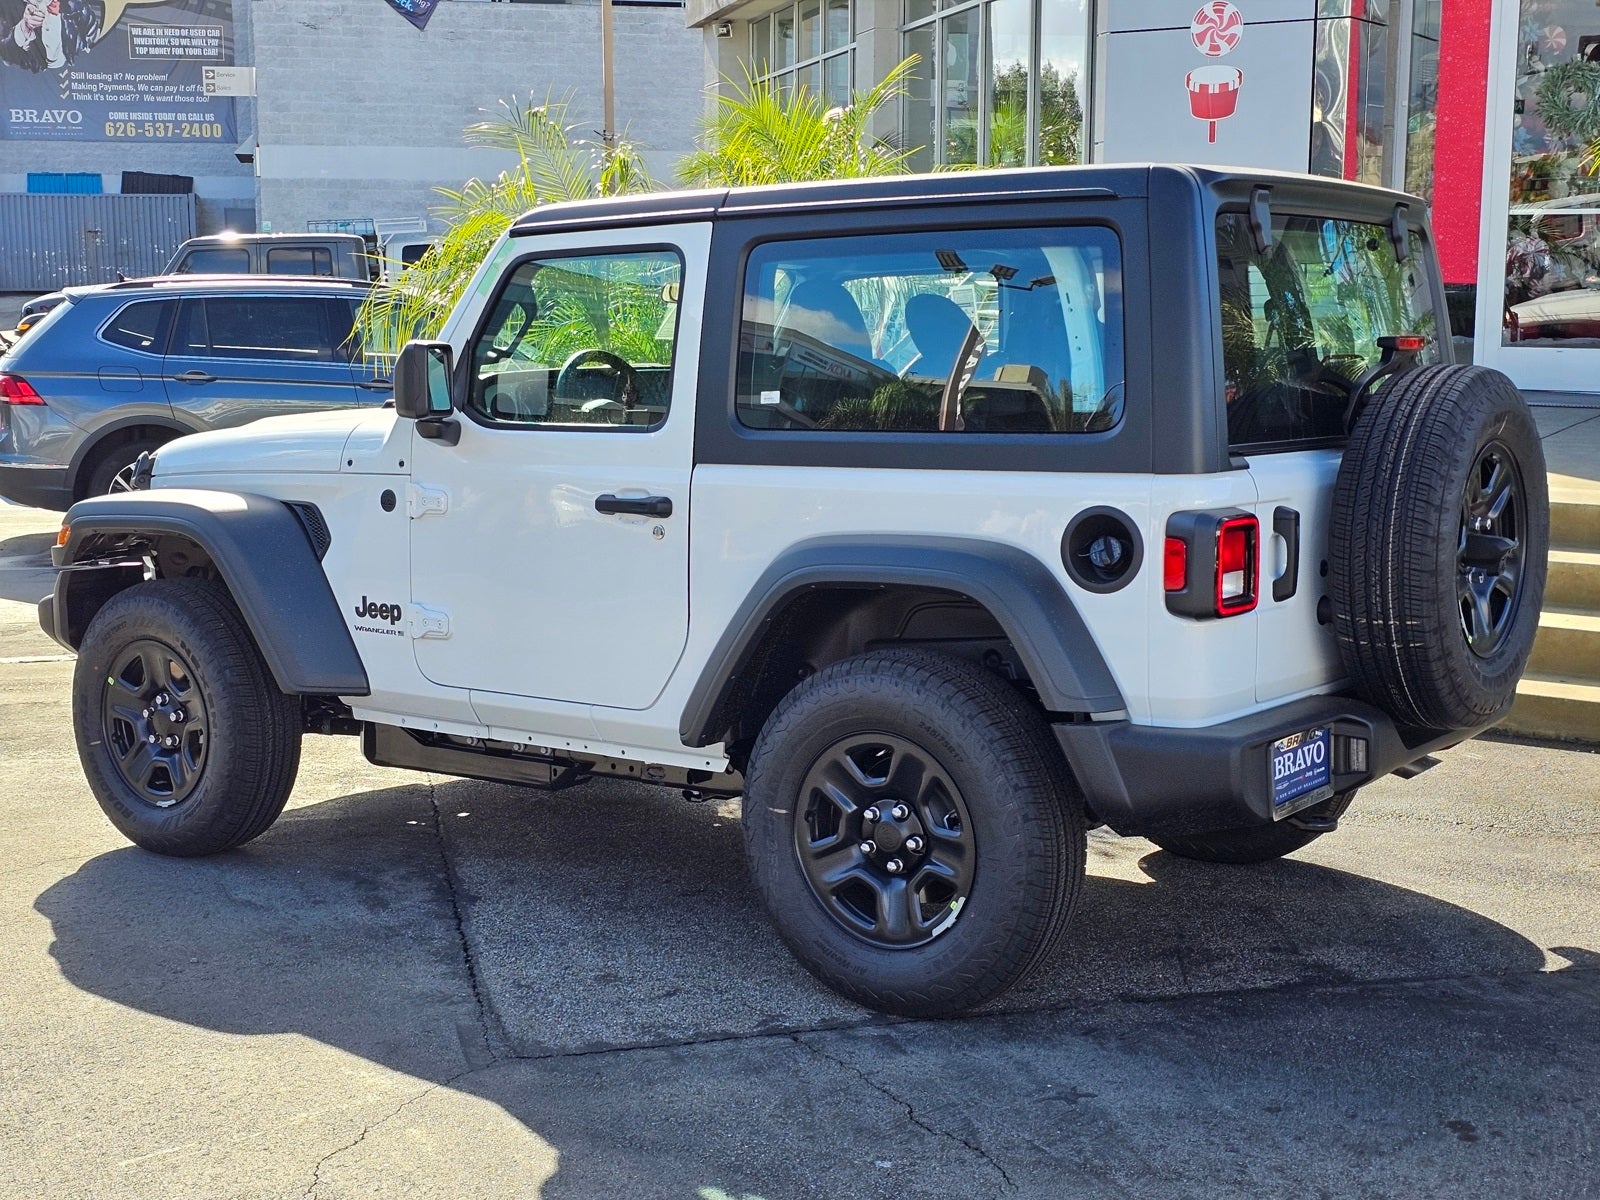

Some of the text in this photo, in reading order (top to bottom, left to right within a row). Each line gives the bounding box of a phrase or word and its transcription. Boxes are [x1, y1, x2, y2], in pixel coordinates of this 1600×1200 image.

[207, 29, 220, 37] CAR
[180, 38, 190, 46] WE
[149, 47, 171, 55] MONEY
[203, 48, 219, 56] CAR!
[70, 71, 168, 82] Still leasing it? No problem!
[71, 82, 97, 92] Making
[98, 83, 136, 93] Payments,
[137, 83, 149, 92] We
[179, 84, 185, 92] it
[185, 84, 196, 92] off
[72, 92, 93, 101] Think
[94, 93, 105, 101] it's
[105, 93, 118, 101] too
[119, 93, 140, 102] old??
[143, 94, 155, 102] We
[174, 95, 195, 103] those
[195, 95, 210, 103] too!
[9, 108, 83, 124] BRAVO
[108, 112, 215, 121] COME INSIDE TODAY OR CALL US
[105, 121, 223, 138] 626-537-2400
[355, 595, 402, 625] Jeep
[354, 624, 397, 636] WRANGLER
[1273, 740, 1325, 780] BRAVO
